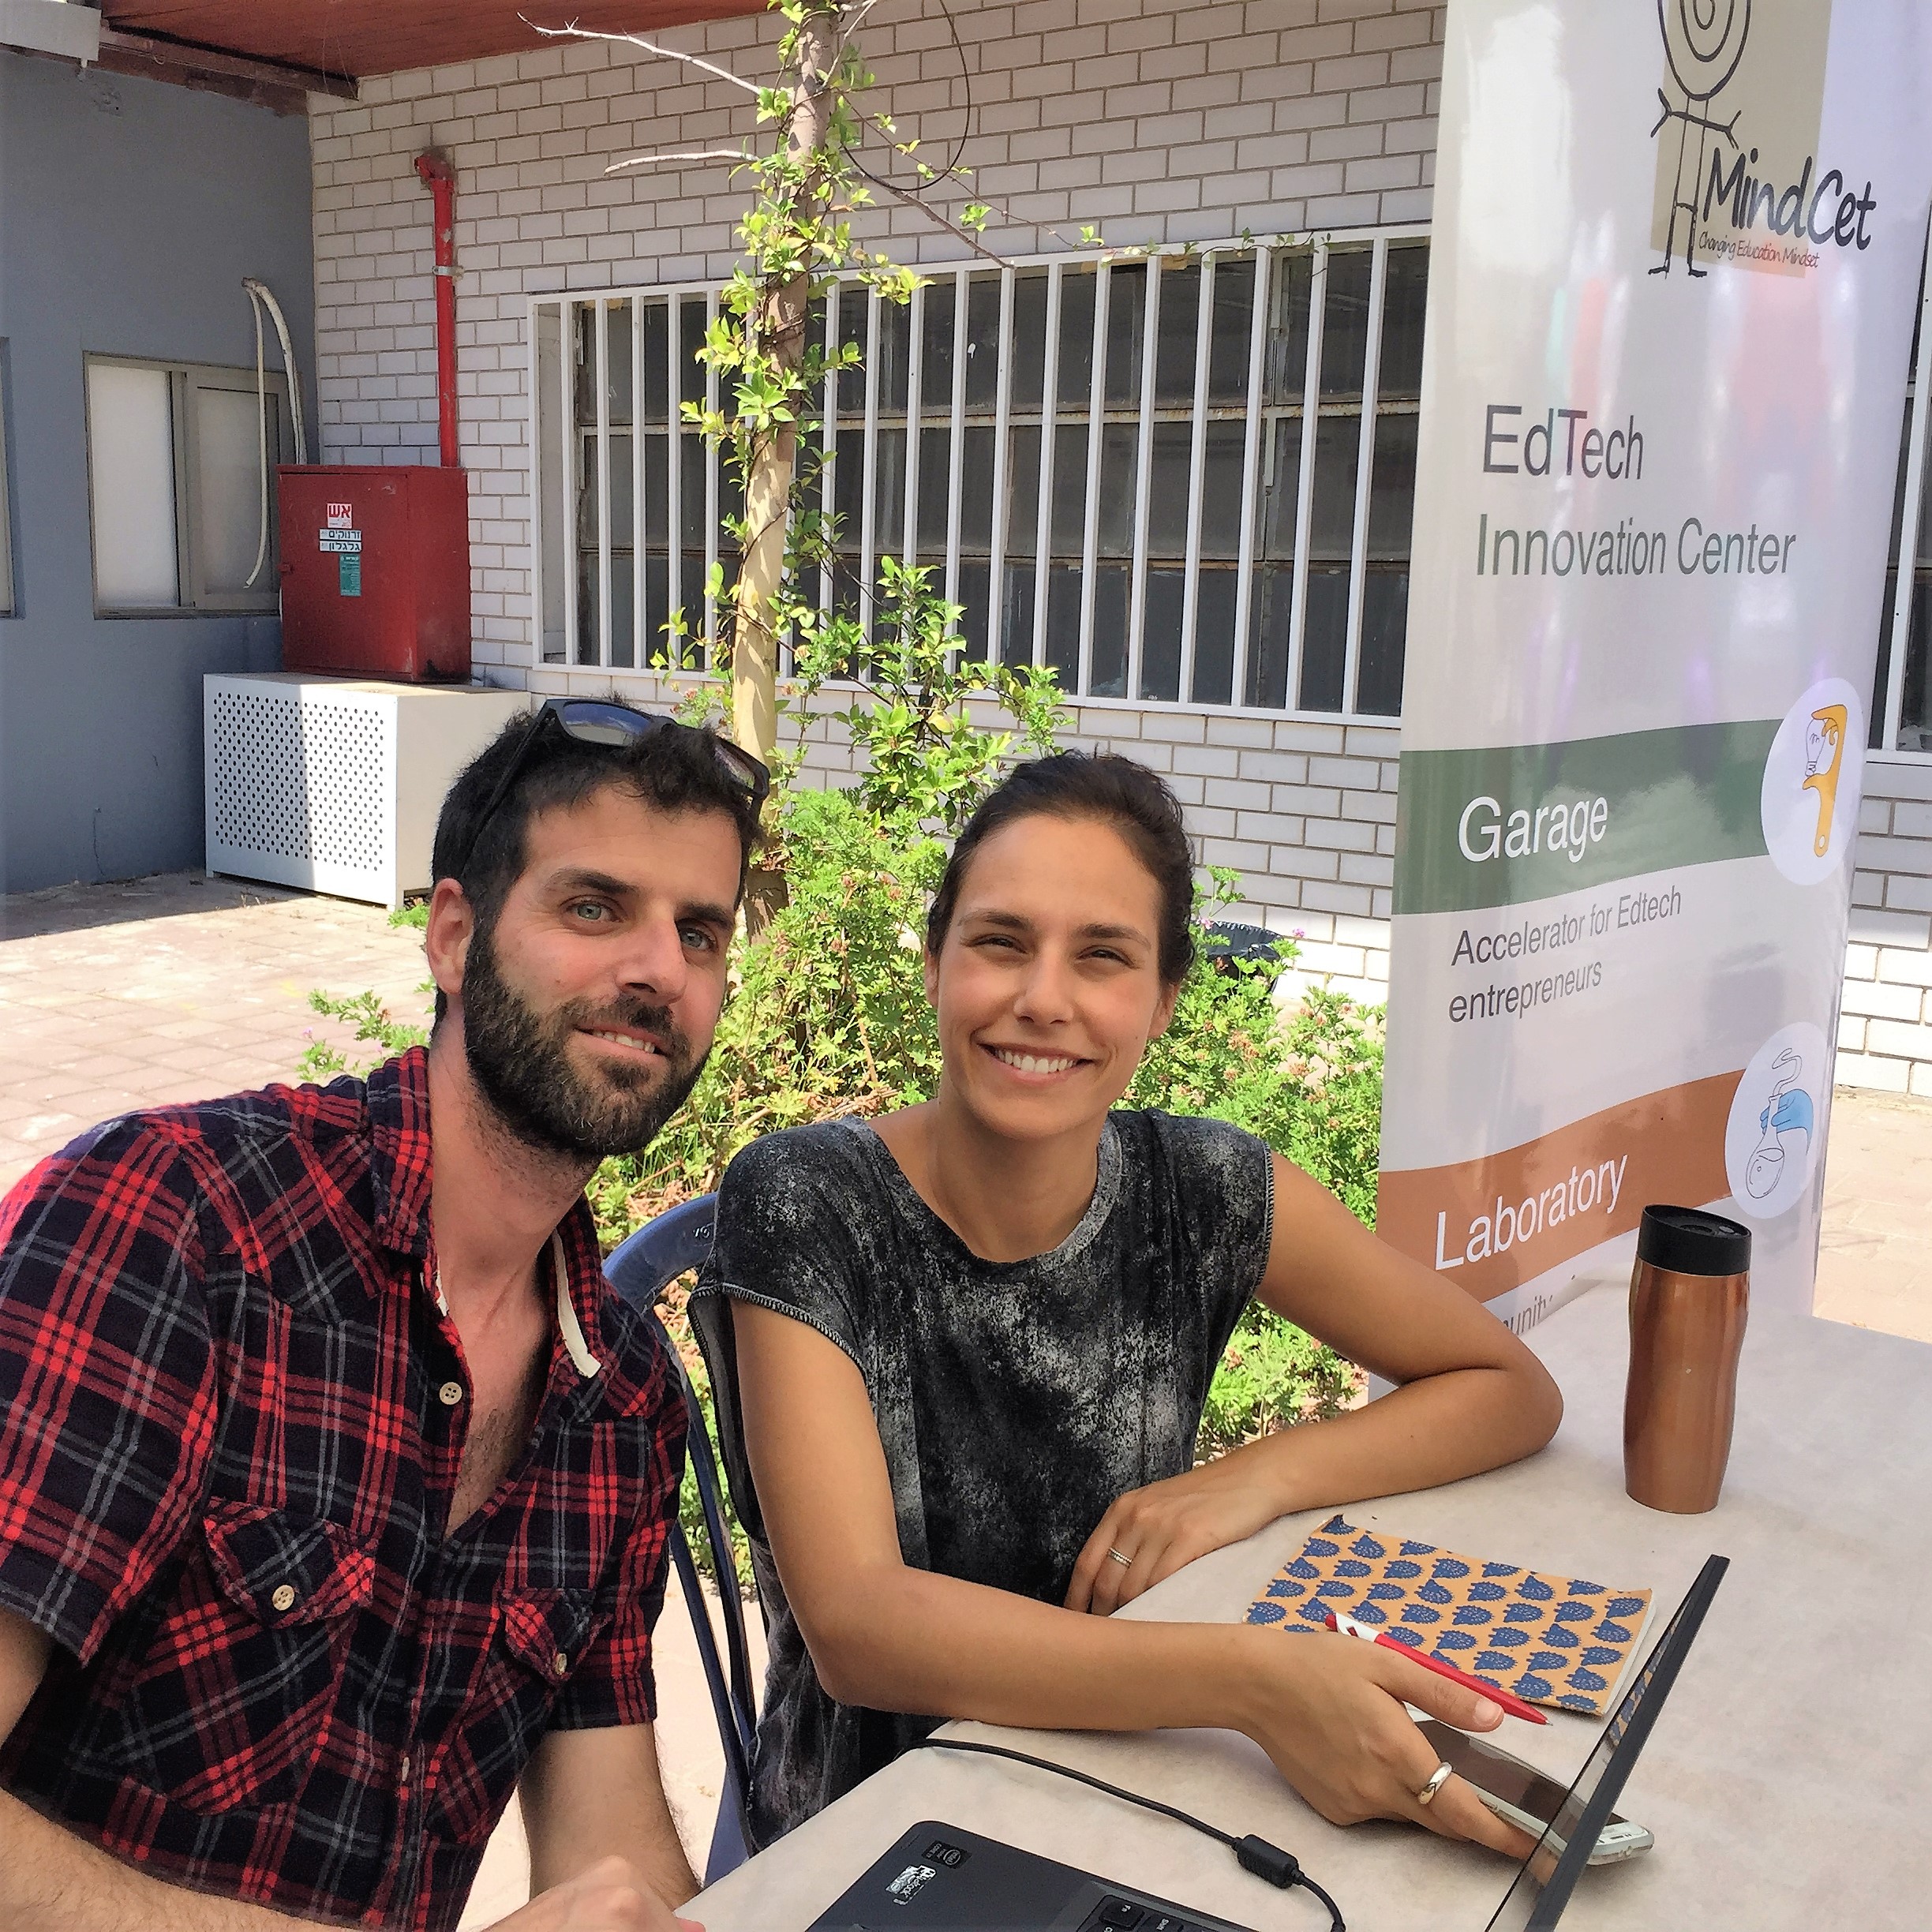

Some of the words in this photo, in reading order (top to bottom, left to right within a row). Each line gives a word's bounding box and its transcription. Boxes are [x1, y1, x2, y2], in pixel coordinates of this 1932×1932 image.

[1703, 148, 1877, 250] MindCet
[1698, 231, 1736, 261] Changing
[1736, 240, 1781, 262] Education
[1782, 246, 1820, 268] Mindset
[1483, 404, 1644, 480] EdTech
[328, 504, 350, 519] אש
[328, 530, 361, 540] זרנוקים
[328, 541, 361, 552] גלגלון
[1477, 514, 1667, 577] Innovation
[1677, 517, 1796, 576] Center
[1458, 796, 1608, 863] Garage
[1451, 914, 1586, 966] Accelerator
[1589, 903, 1613, 938] for
[1616, 885, 1682, 930] Edtech
[1448, 960, 1602, 1023] entrepreneurs
[1434, 1154, 1628, 1271] Laboratory
